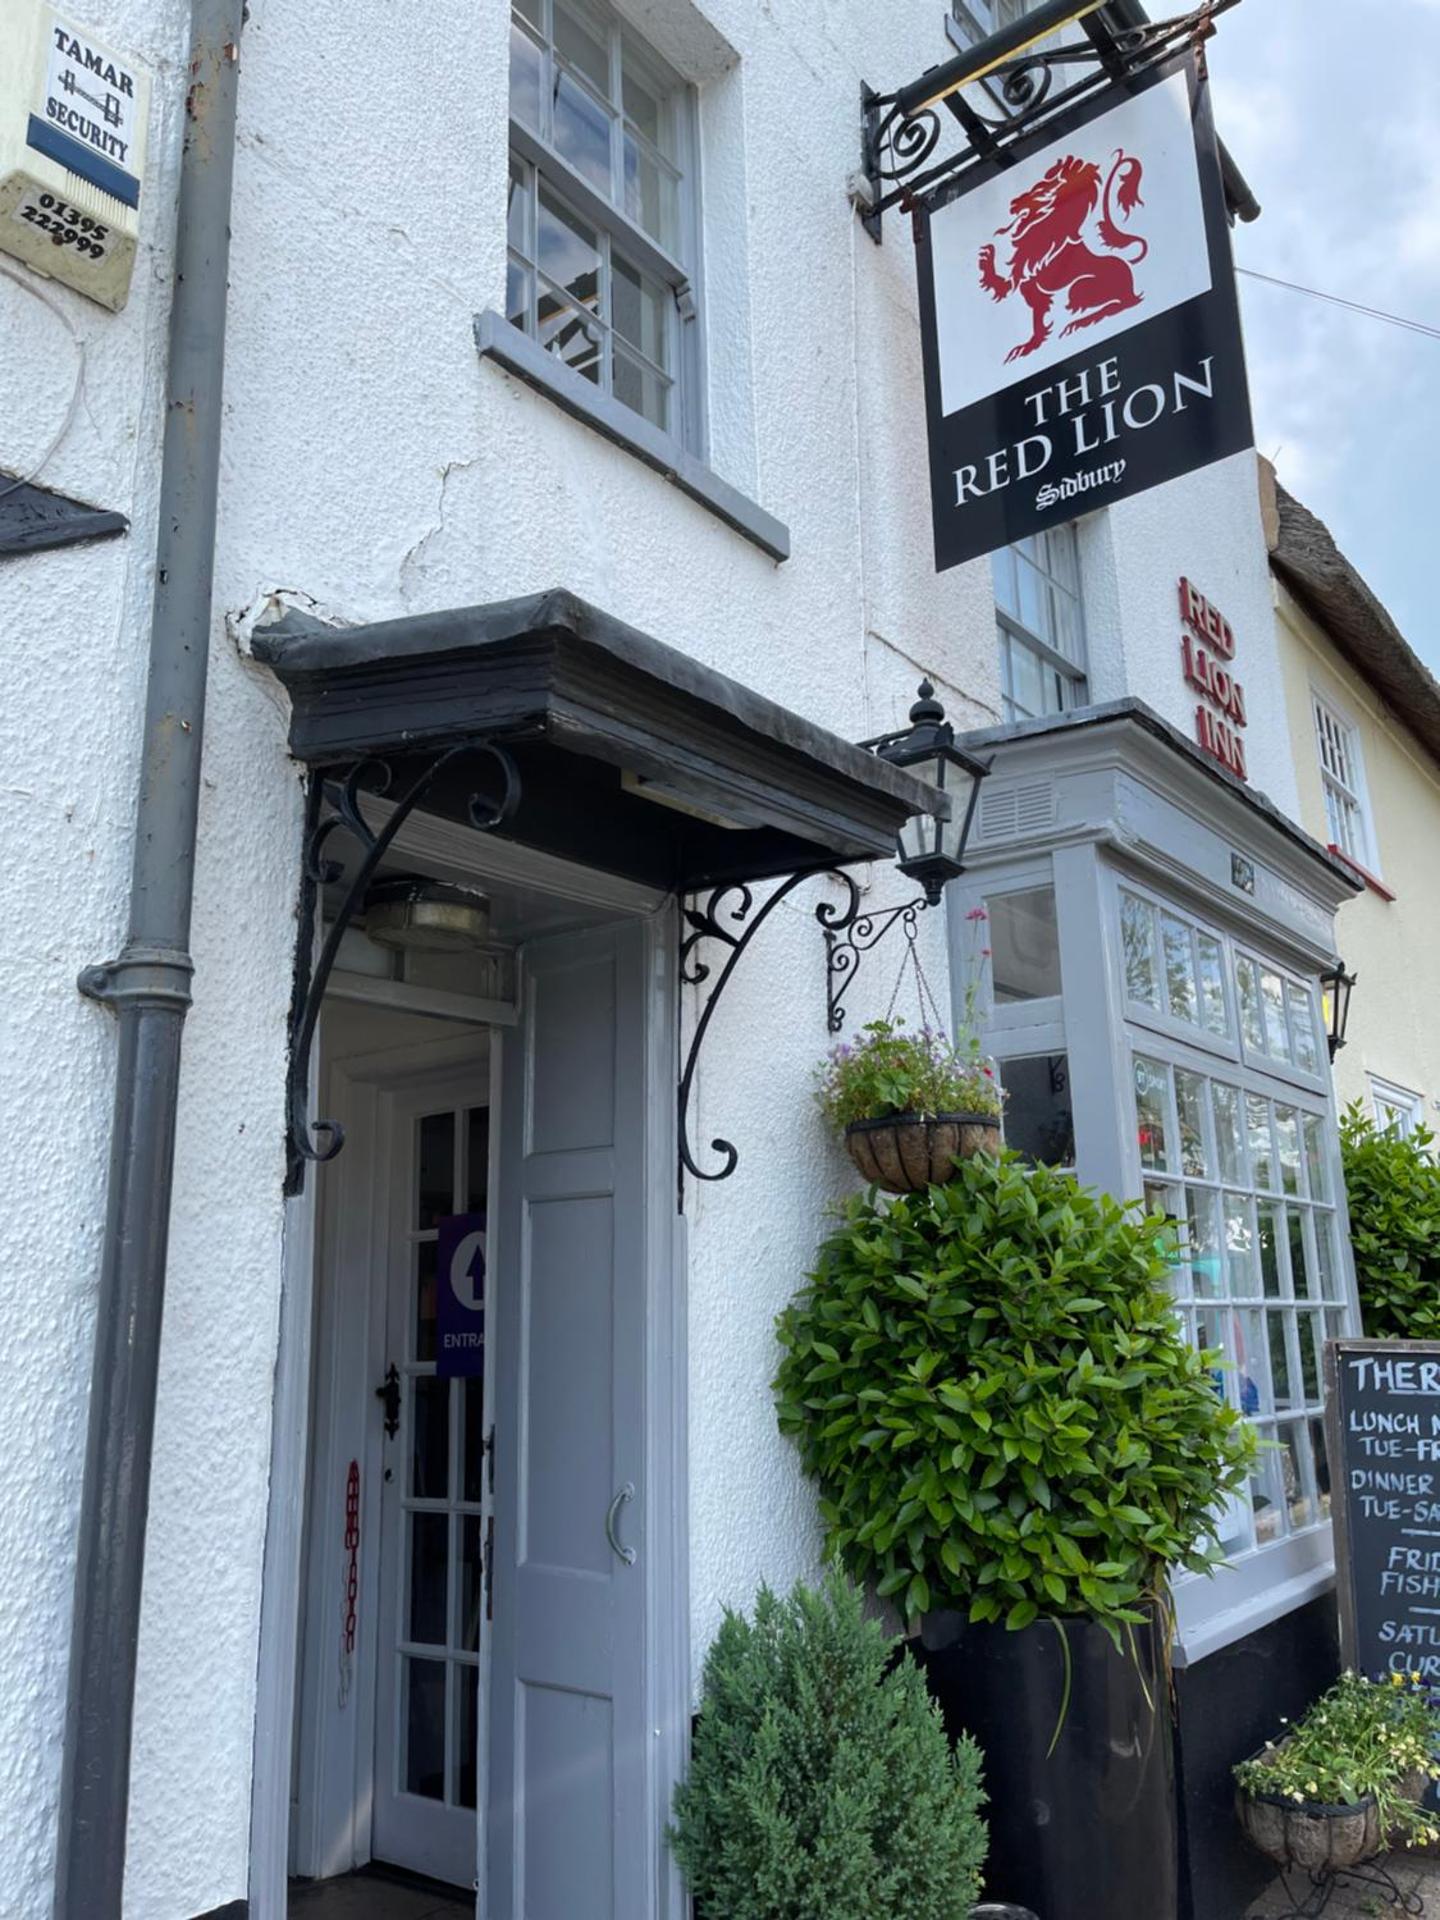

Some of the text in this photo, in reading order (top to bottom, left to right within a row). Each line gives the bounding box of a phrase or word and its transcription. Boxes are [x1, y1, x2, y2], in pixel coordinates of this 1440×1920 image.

[54, 28, 134, 99] TAMAR
[46, 96, 128, 163] SECURITY
[21, 205, 105, 259] 222999
[39, 193, 109, 241] 01395
[1024, 356, 1121, 427] THE
[952, 356, 1215, 508] RED LION
[1036, 458, 1127, 512] Sidbury
[1179, 576, 1236, 661] RED
[1181, 634, 1247, 728] LION
[1196, 704, 1248, 782] INN
[1350, 1409, 1420, 1436] LUNCH
[1351, 1469, 1434, 1496] DINNER
[1380, 1571, 1440, 1598] FISH
